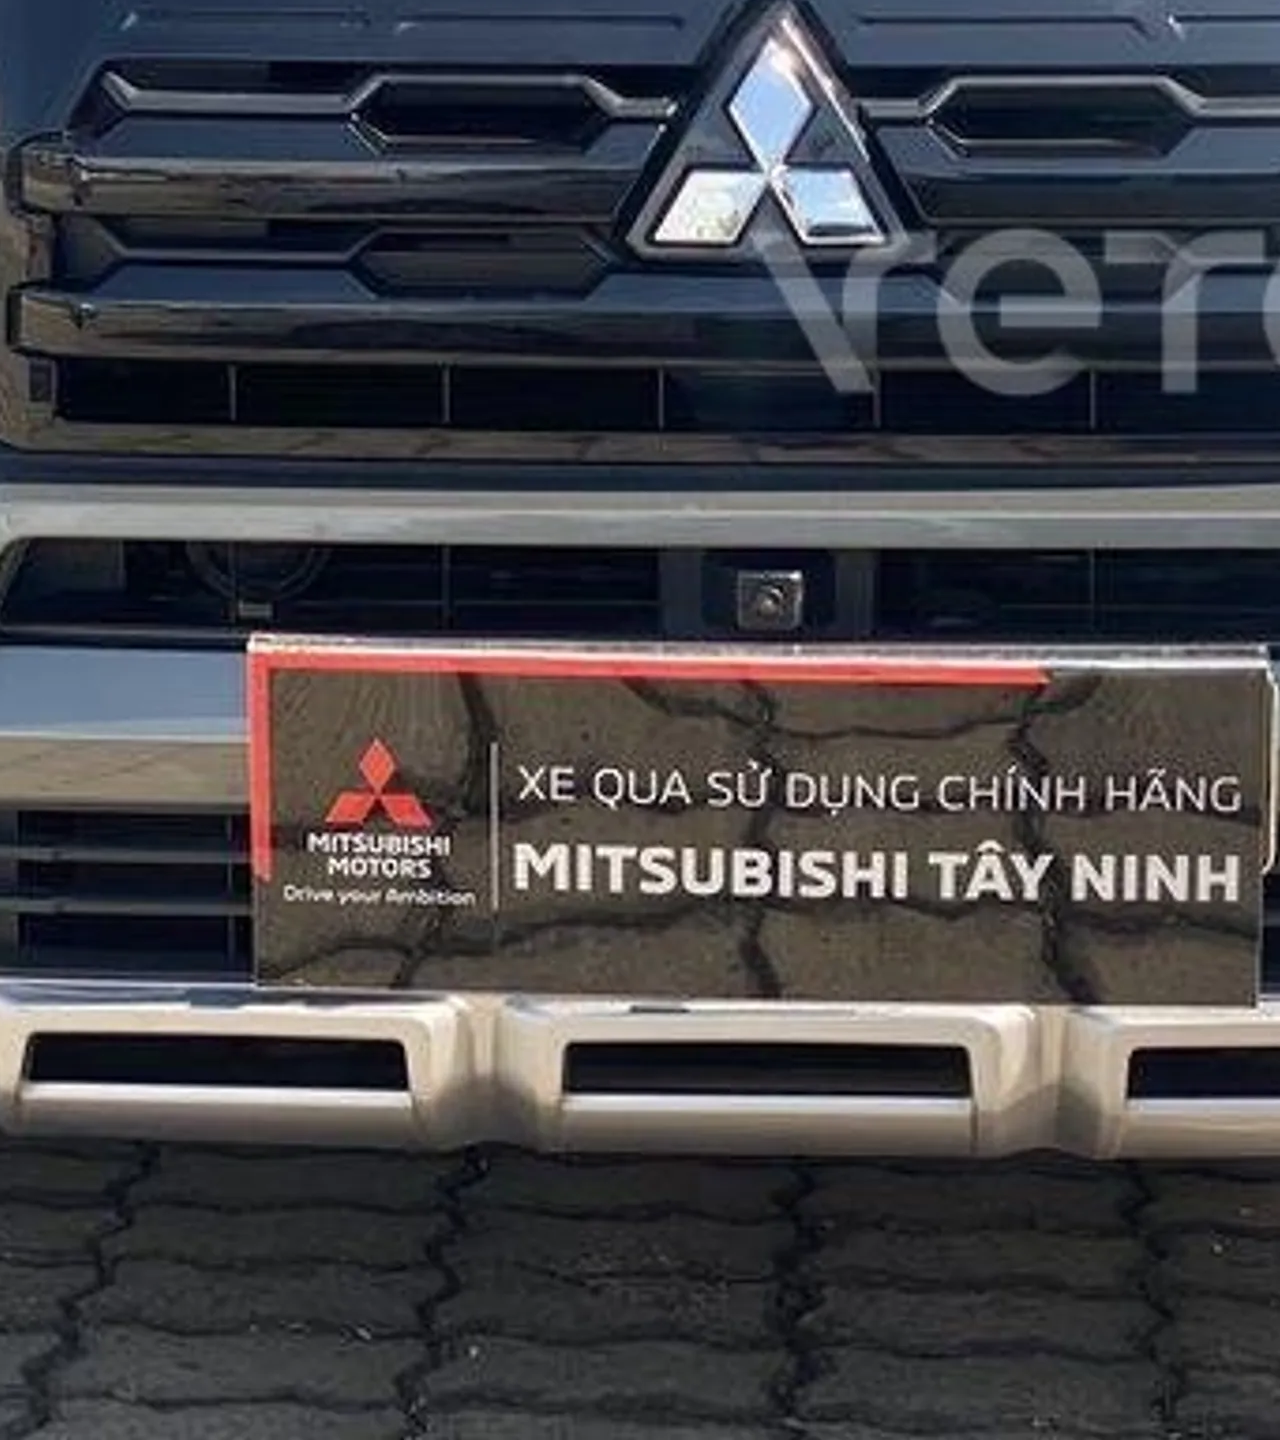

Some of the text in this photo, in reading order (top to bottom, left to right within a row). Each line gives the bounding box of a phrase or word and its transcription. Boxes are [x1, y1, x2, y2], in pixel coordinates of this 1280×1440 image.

[518, 759, 1242, 816] XE QUA SỬ DỤNG CHÍNH HÃNG
[306, 832, 452, 857] MITSUBISHI
[328, 857, 433, 879] MOTORS
[514, 839, 1240, 903] MITSUBISHI TÂY NINH
[283, 884, 476, 907] Drive your Ambition
